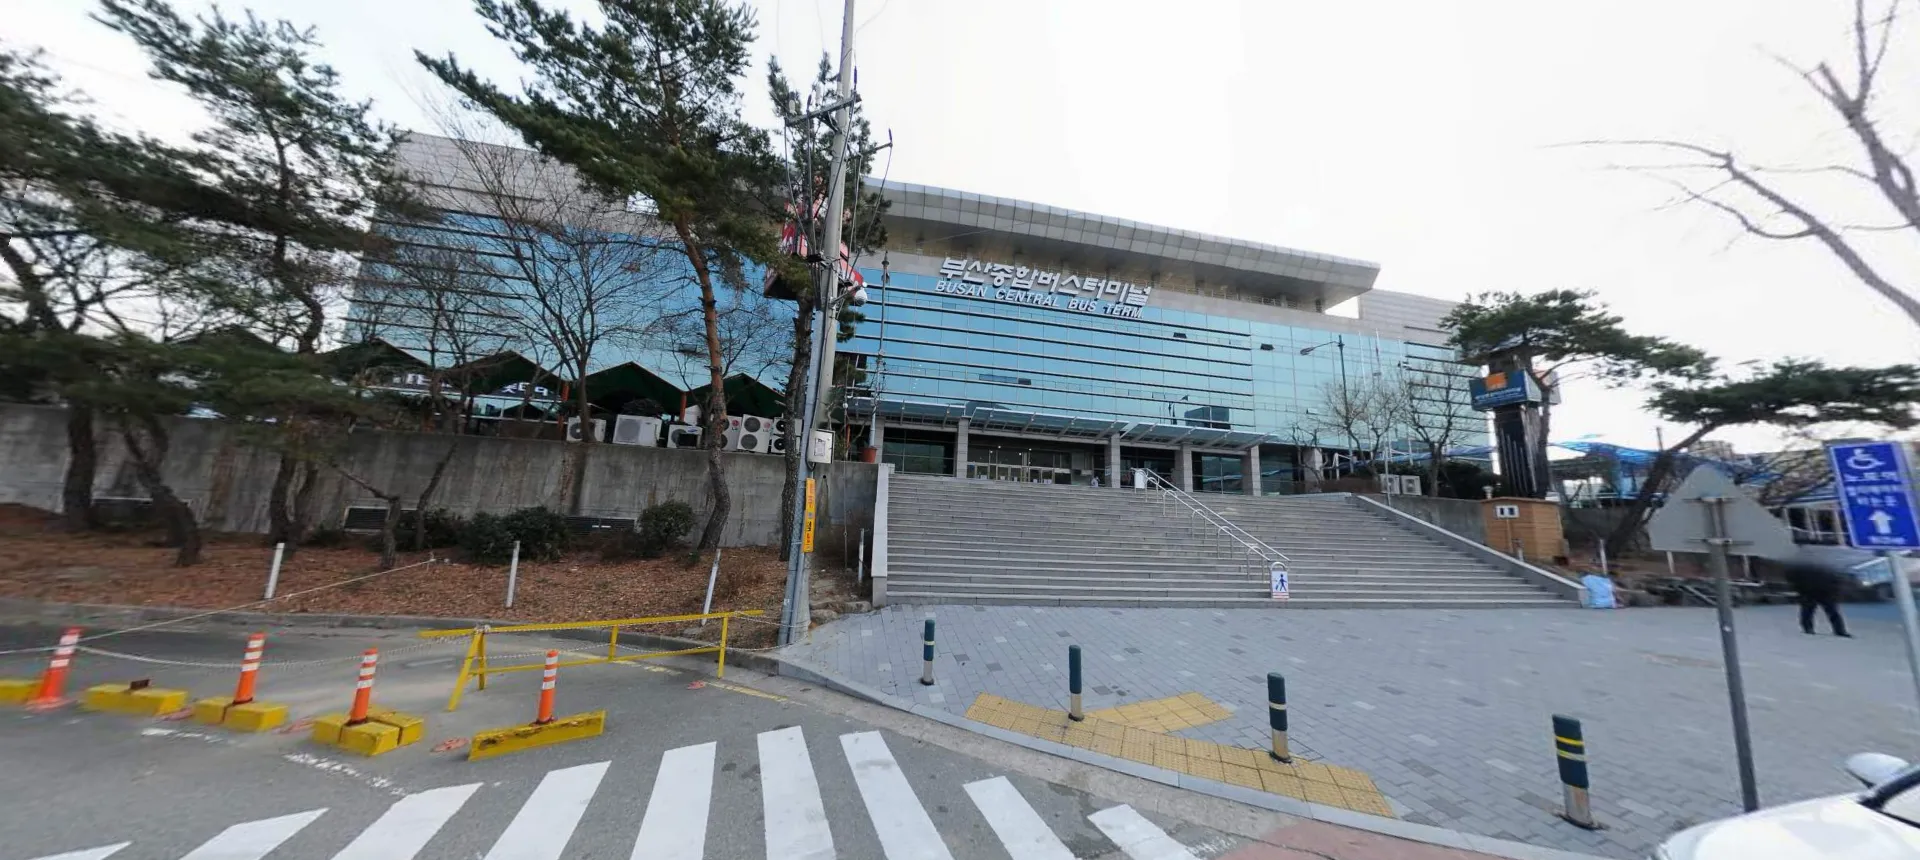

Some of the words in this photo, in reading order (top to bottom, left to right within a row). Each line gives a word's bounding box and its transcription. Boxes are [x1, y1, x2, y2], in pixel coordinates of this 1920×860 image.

[935, 280, 988, 297] BUSAN
[995, 288, 1060, 307] CENTRAL
[1068, 298, 1098, 312] BUS
[939, 256, 1152, 306] 부산종합버스터미널
